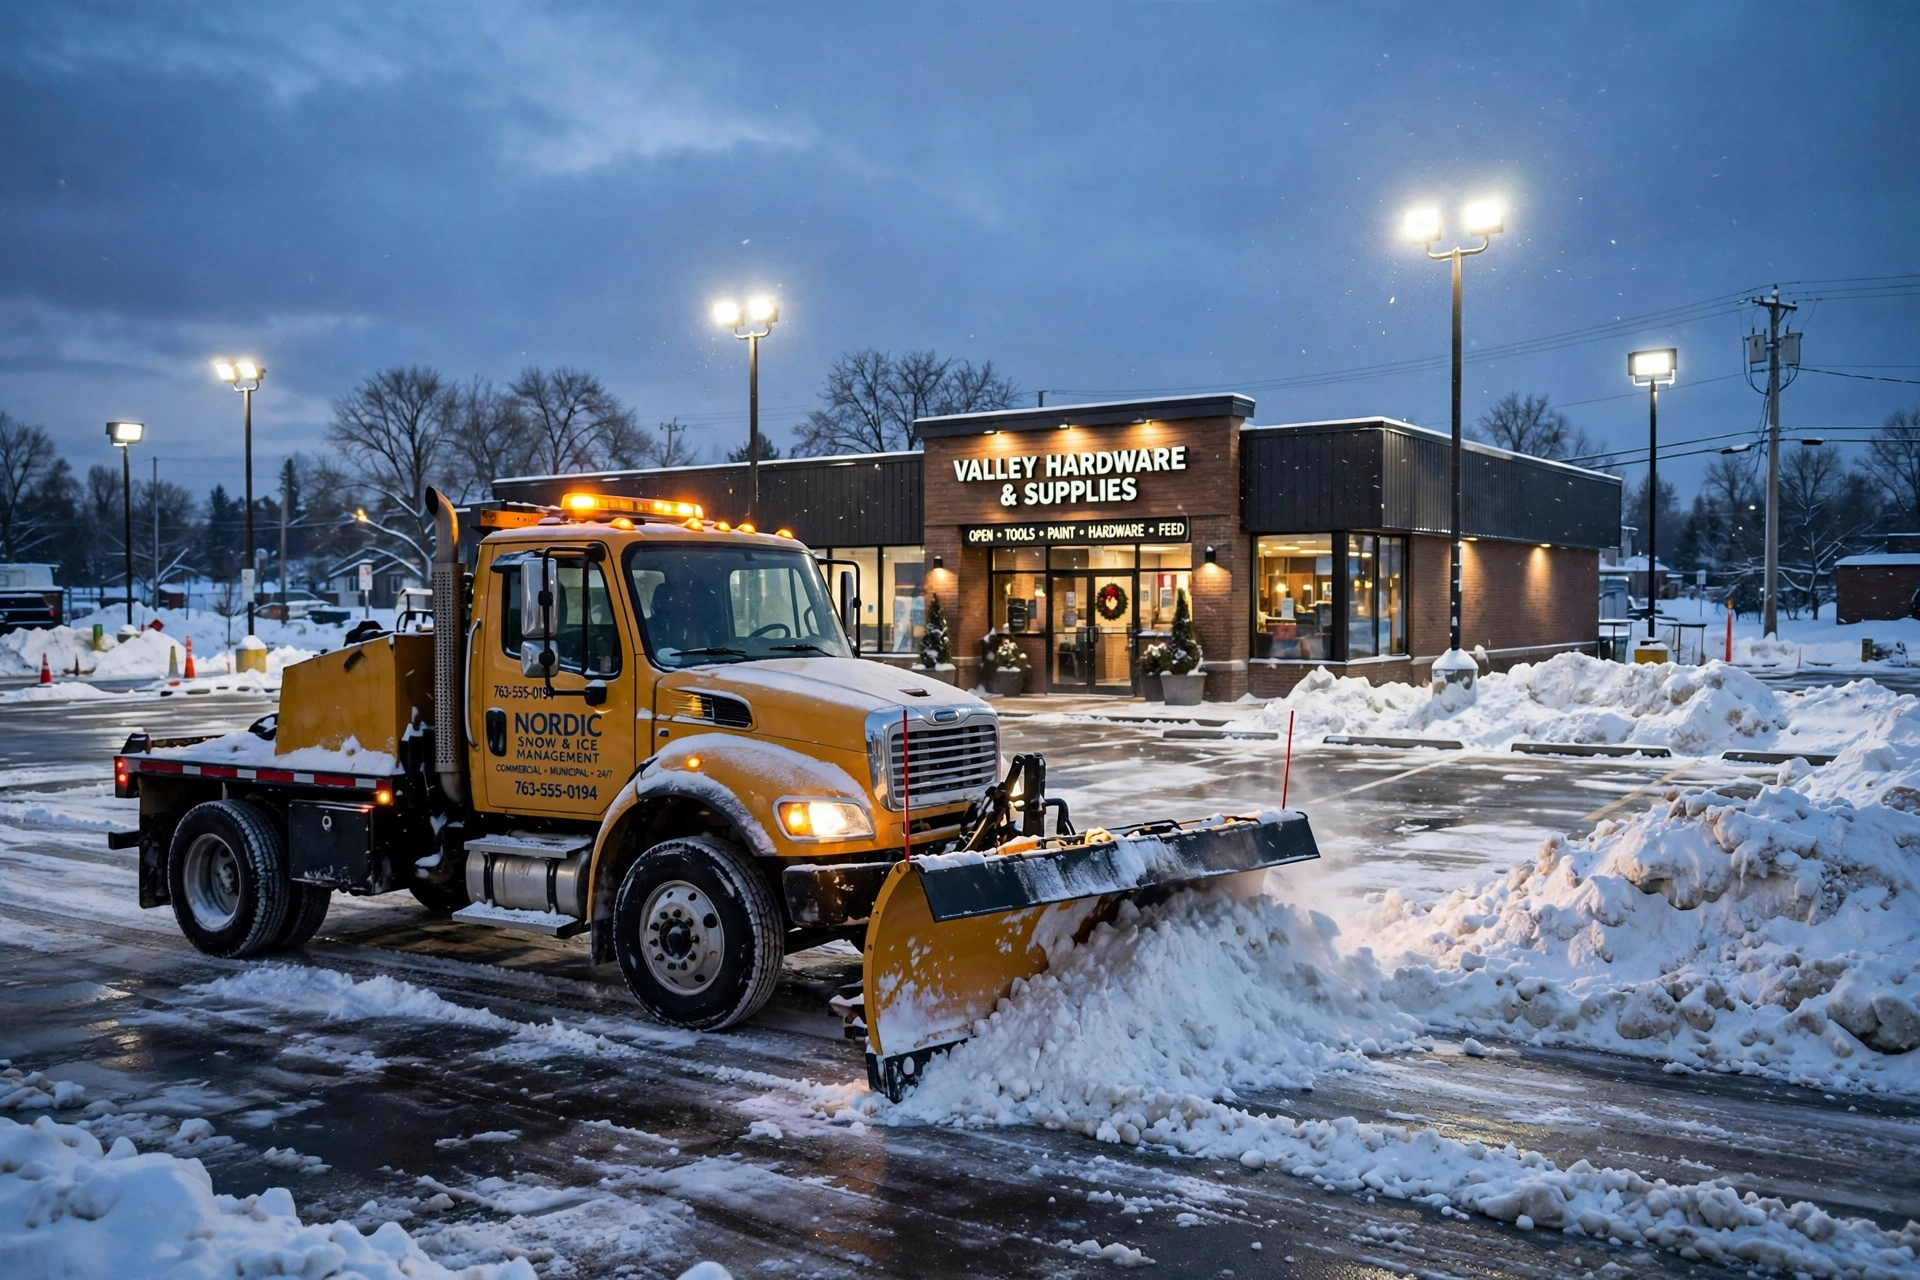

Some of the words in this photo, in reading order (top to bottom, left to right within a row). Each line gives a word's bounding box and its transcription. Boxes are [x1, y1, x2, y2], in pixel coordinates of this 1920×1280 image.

[953, 455, 1038, 482] VALLEY
[1046, 446, 1186, 477] HARDWARE
[1000, 484, 1017, 506] &
[1024, 477, 1137, 505] SUPPLIES
[969, 529, 994, 542] OPEN
[1005, 527, 1035, 541] TOOLS
[1047, 526, 1075, 539] PAINT
[1088, 524, 1144, 539] HARDWARE
[1158, 522, 1184, 536] FEED
[494, 685, 554, 700] 763-555-019
[515, 712, 602, 738] NORDIC
[518, 736, 556, 749] SNOW
[562, 739, 570, 749] &
[576, 739, 597, 751] ICE
[516, 749, 599, 763] MANAGEMENT
[550, 767, 589, 777] MUNICIPAL
[597, 769, 613, 779] 24/7
[515, 781, 598, 800] 763-555-0194
